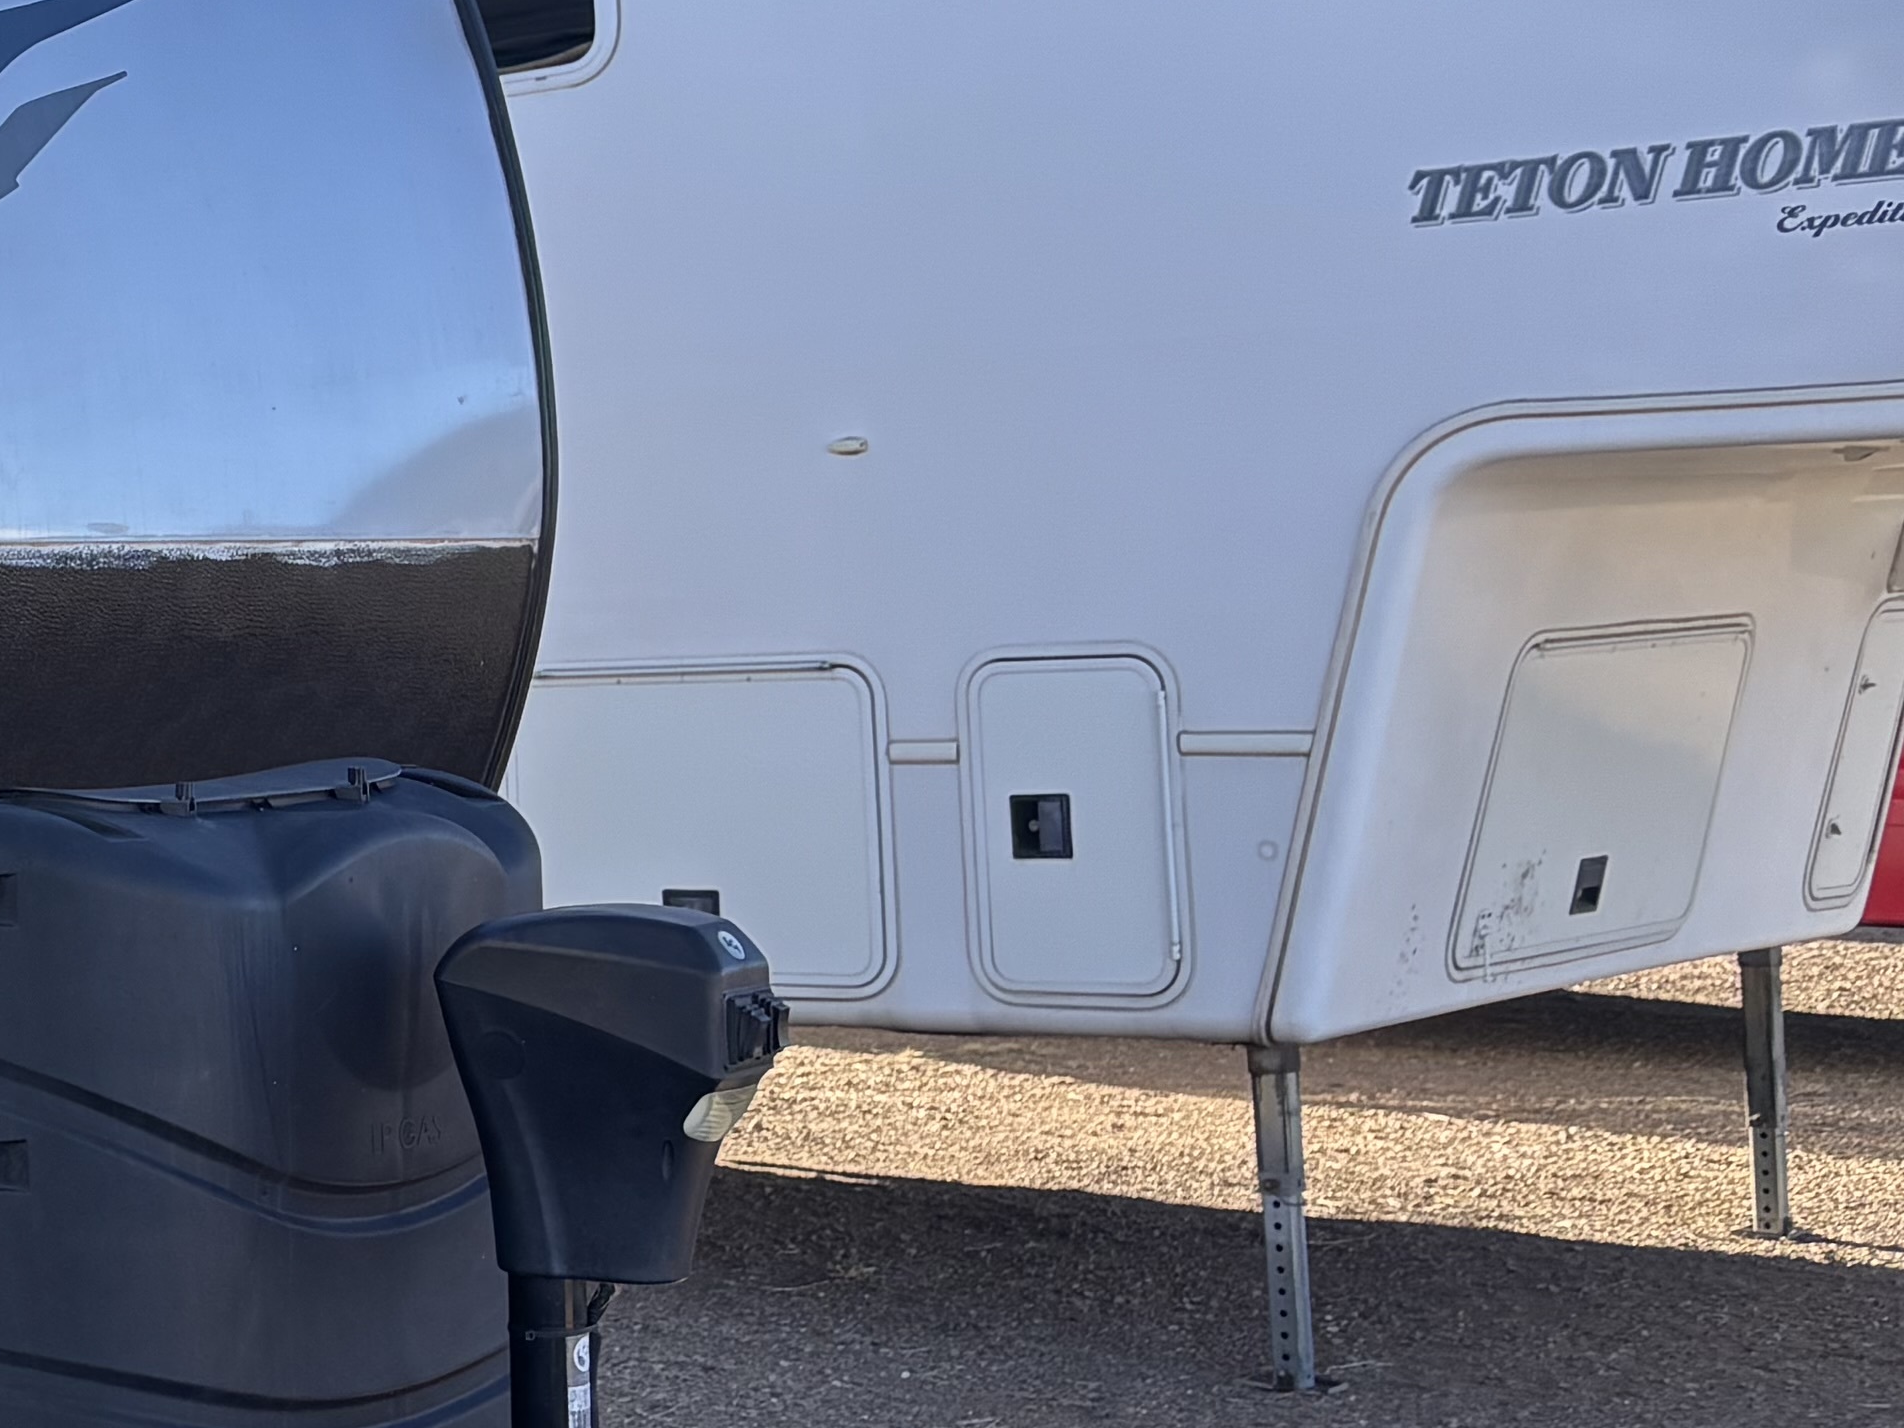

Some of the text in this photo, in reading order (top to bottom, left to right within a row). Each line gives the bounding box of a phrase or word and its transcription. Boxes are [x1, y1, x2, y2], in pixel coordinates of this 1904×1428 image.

[1407, 142, 1677, 228] TETON
[1776, 199, 1904, 238] Expedit
[398, 1115, 442, 1149] GAS
